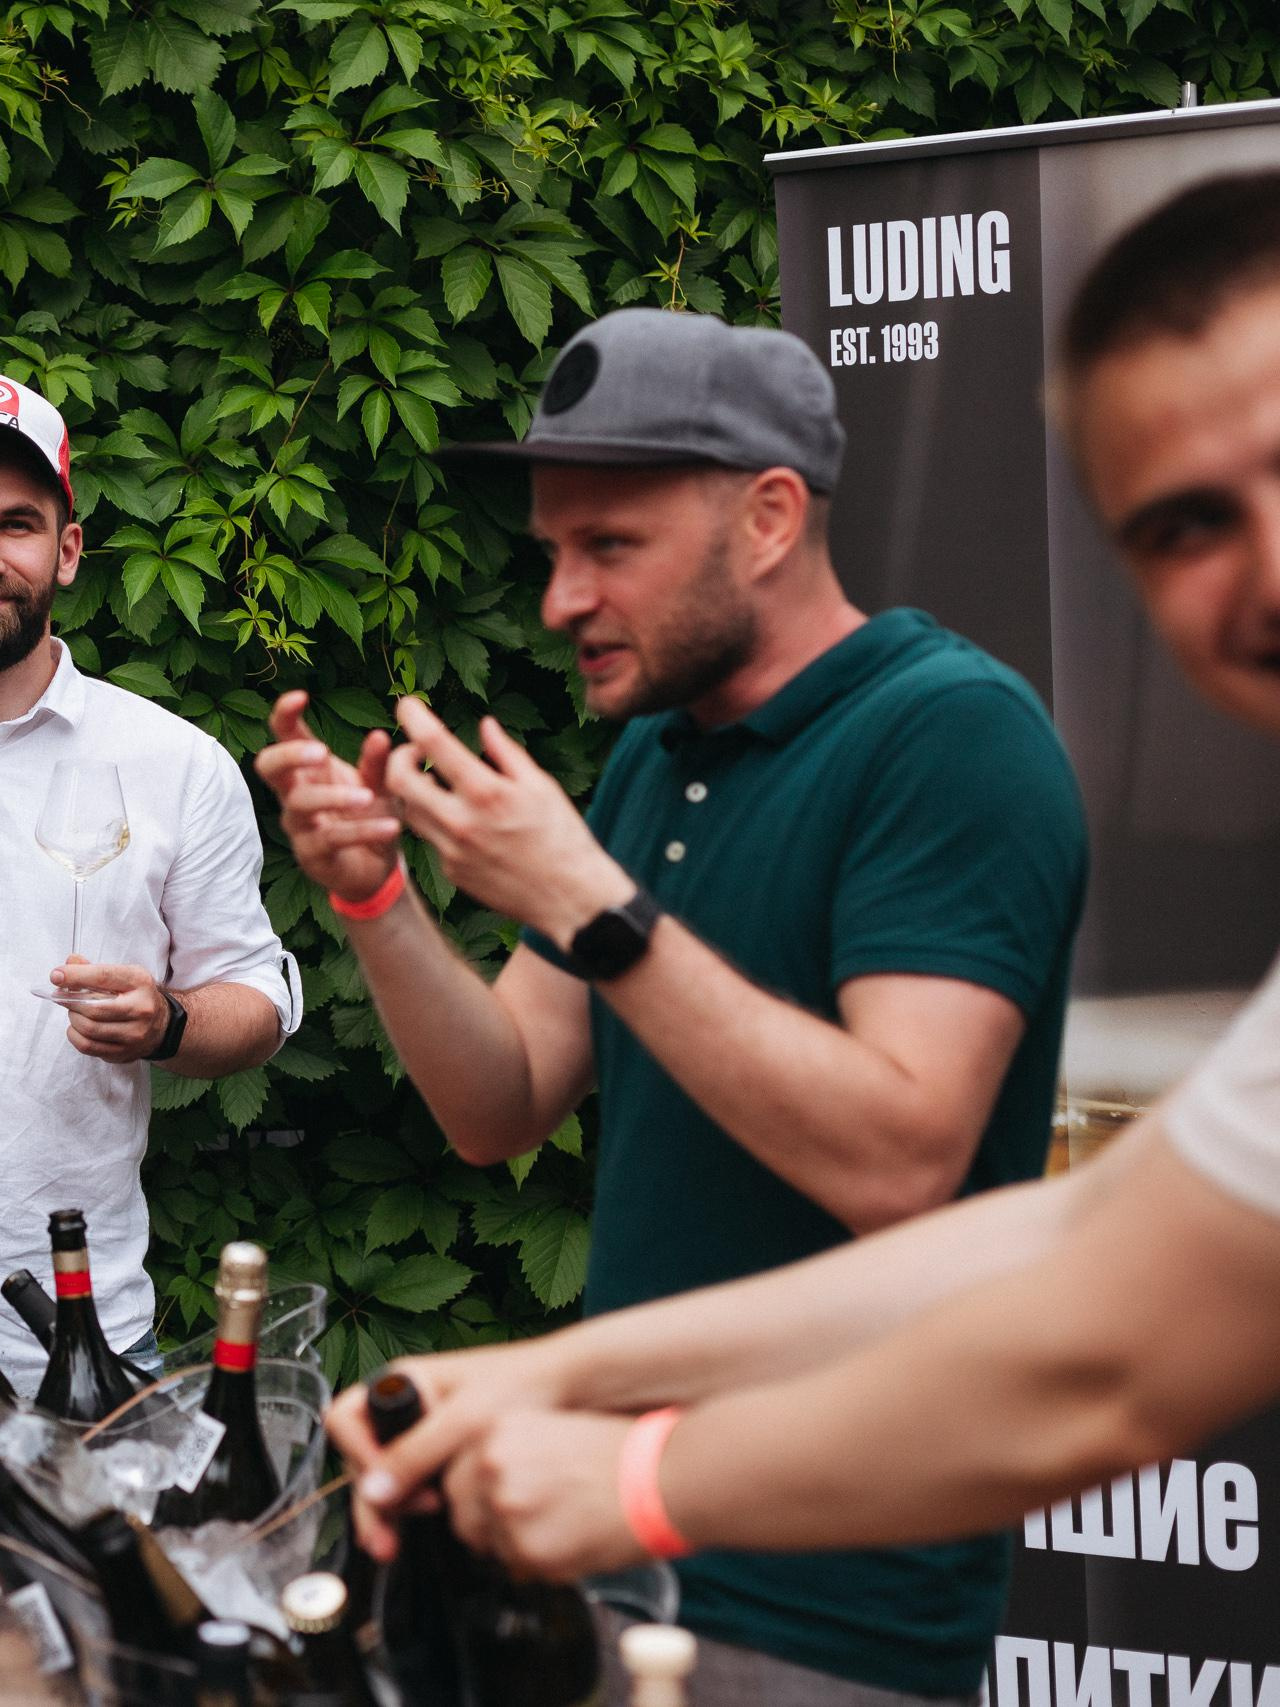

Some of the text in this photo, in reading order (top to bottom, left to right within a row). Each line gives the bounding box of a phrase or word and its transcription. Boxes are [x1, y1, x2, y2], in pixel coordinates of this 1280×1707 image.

[826, 209, 1012, 308] LUDING
[829, 321, 940, 367] EST. 1993
[978, 1634, 1280, 1707] питк
